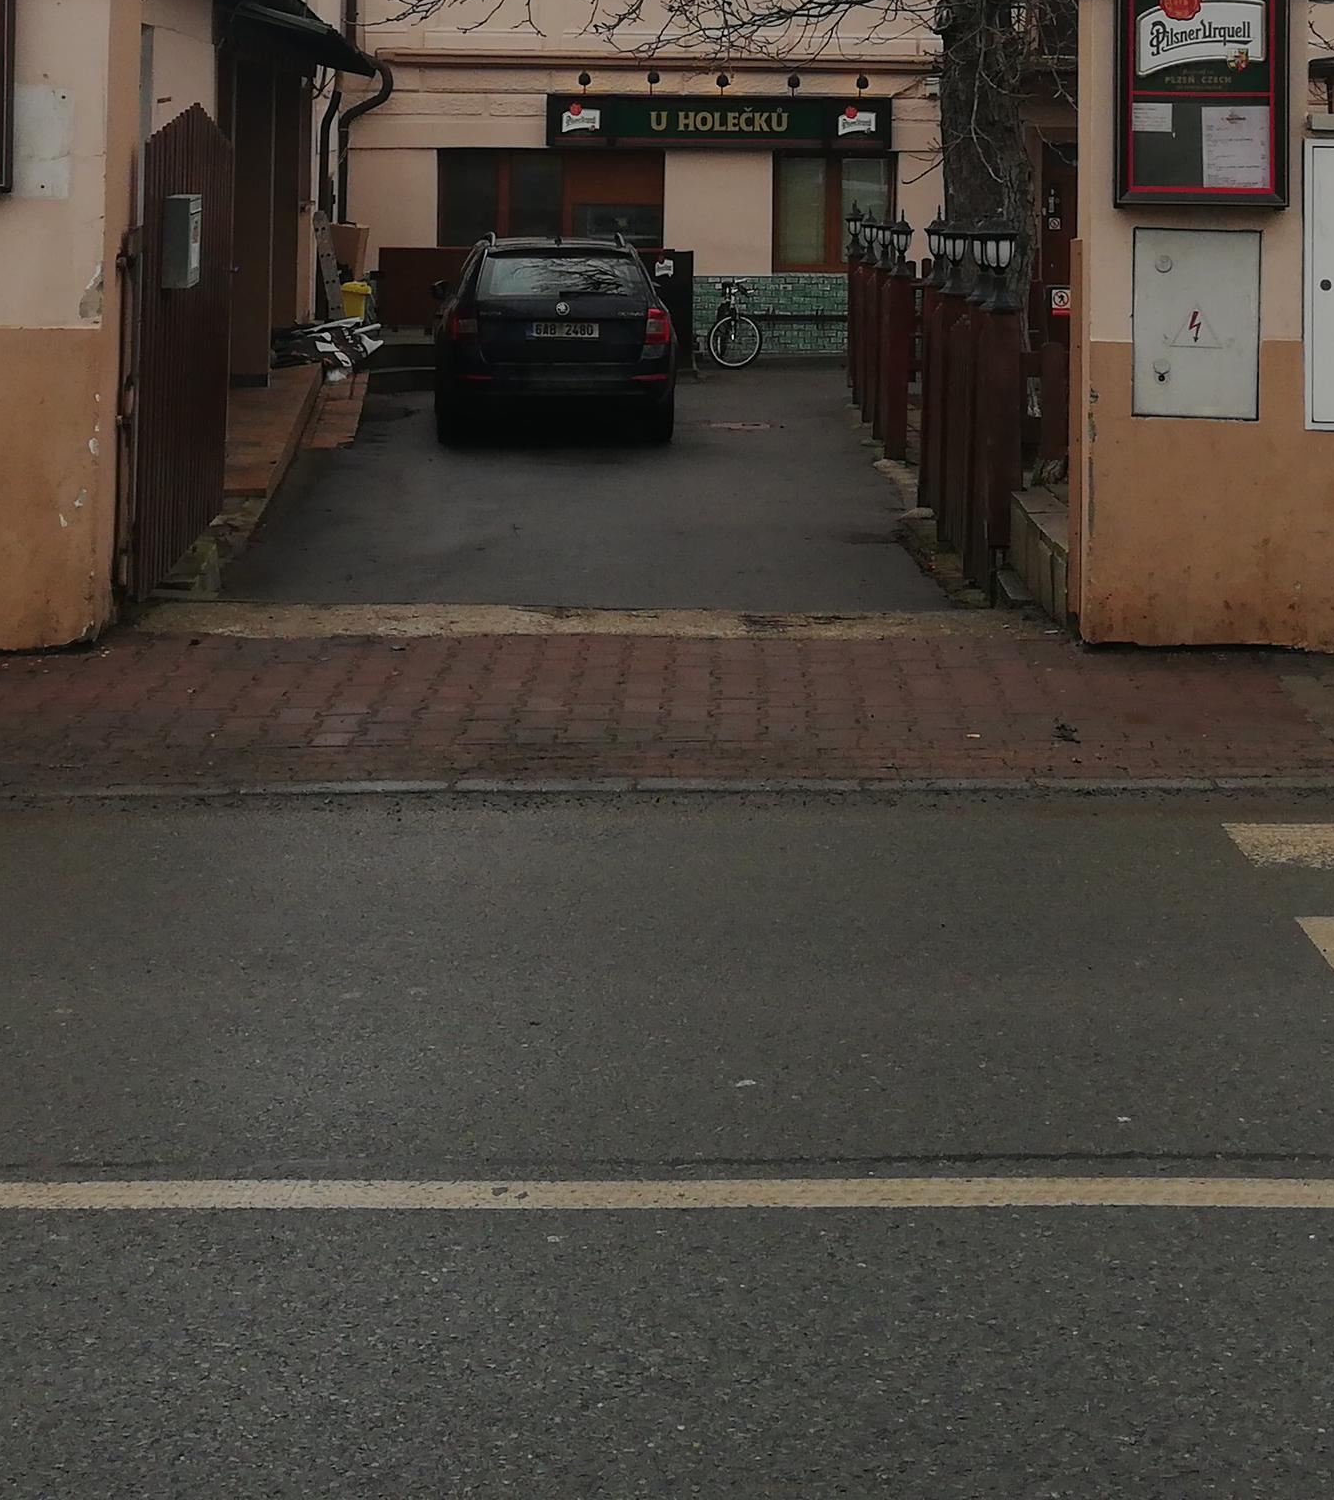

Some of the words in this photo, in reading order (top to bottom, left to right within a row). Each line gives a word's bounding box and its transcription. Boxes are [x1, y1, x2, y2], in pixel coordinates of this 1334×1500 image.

[1149, 20, 1202, 56] Pilsner
[1201, 19, 1251, 46] Urquell
[649, 111, 668, 131] U
[677, 107, 789, 132] HOLEČKŮ
